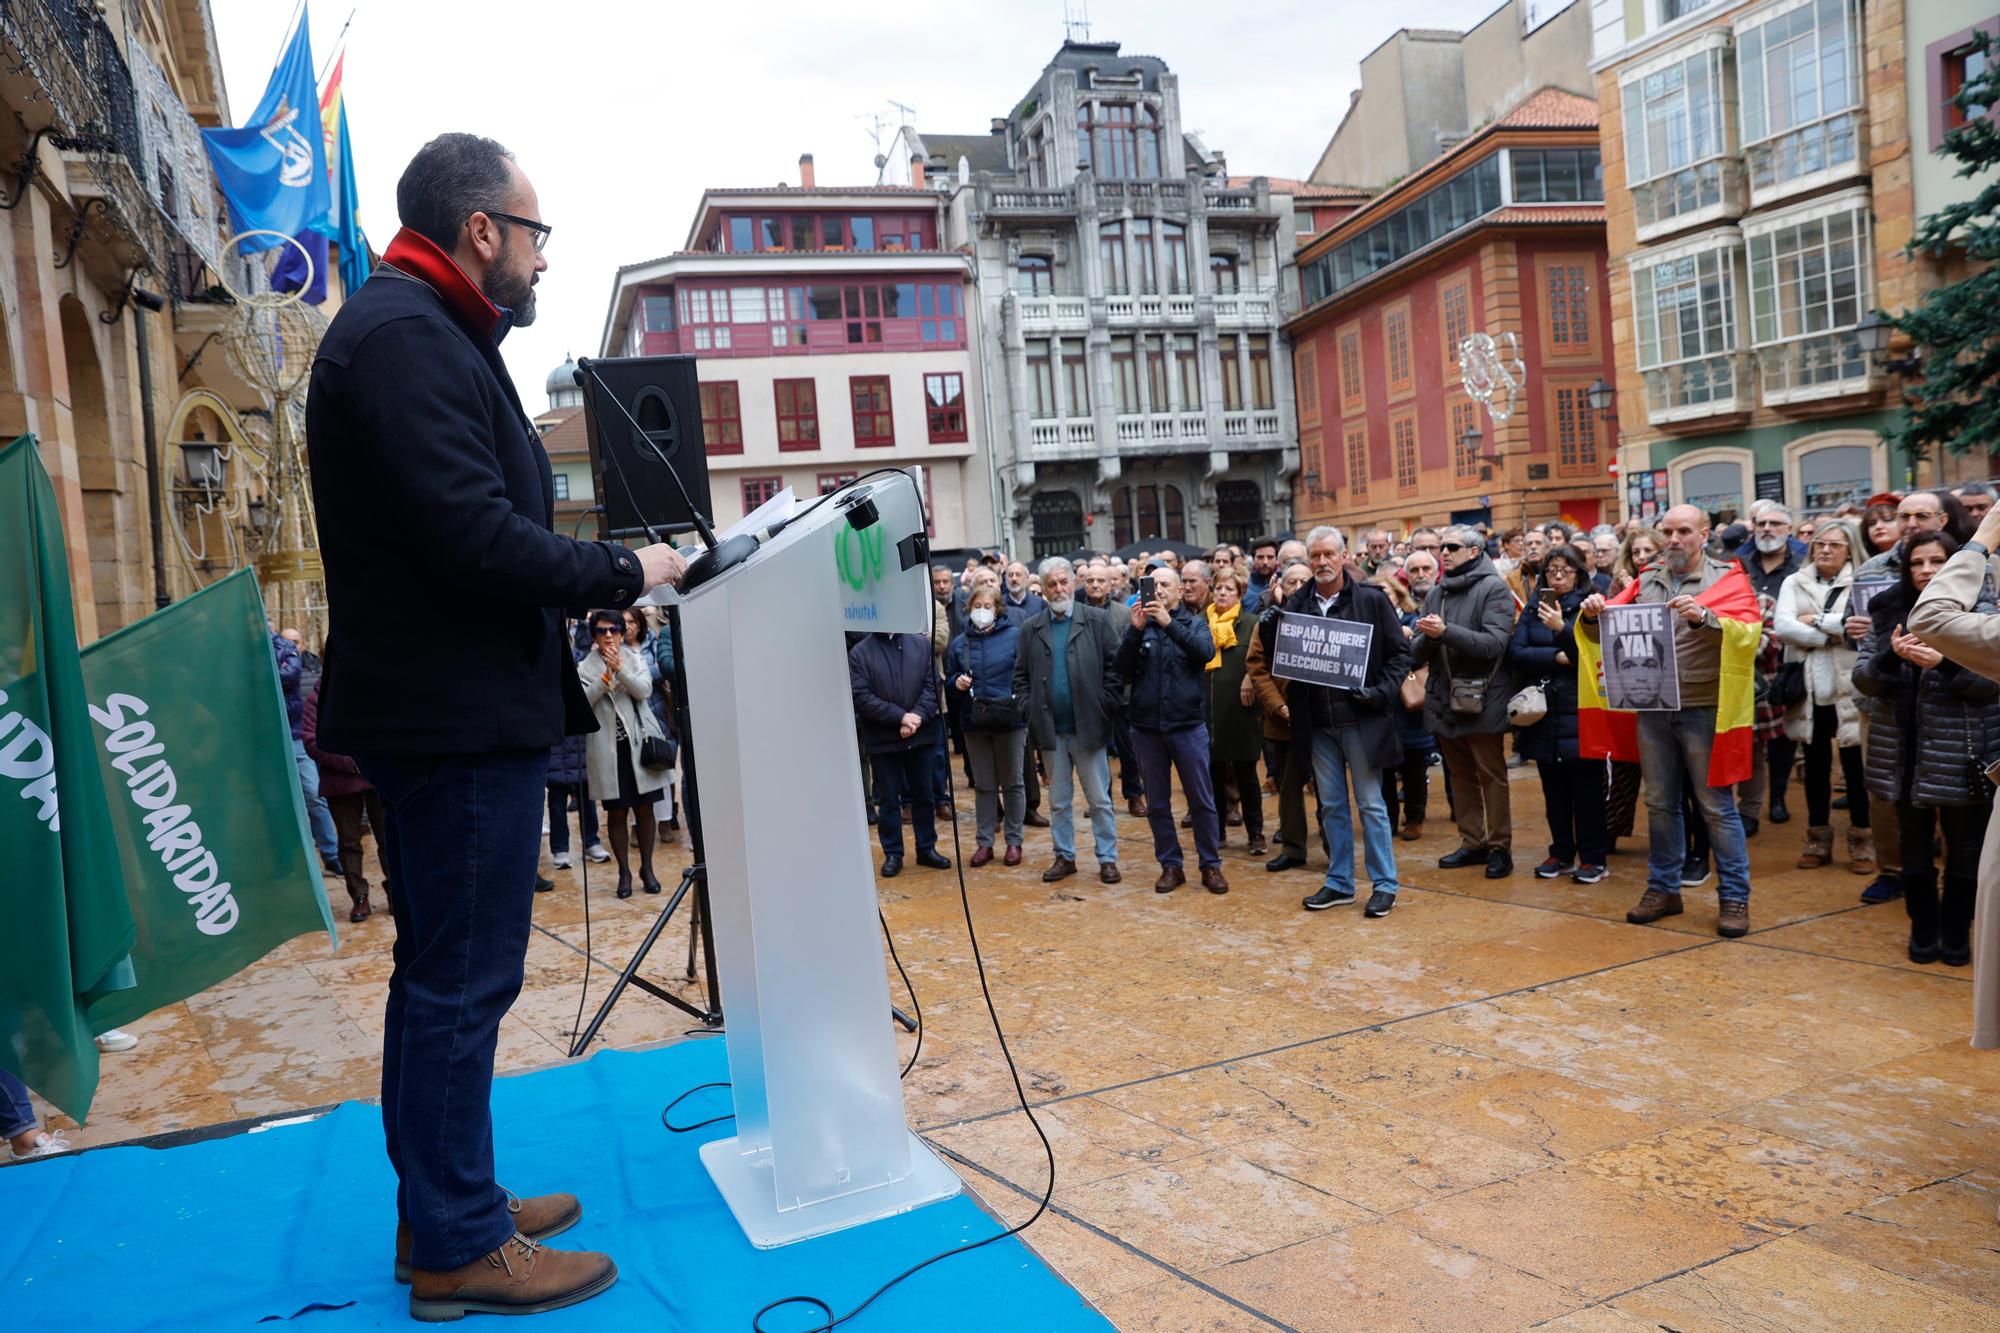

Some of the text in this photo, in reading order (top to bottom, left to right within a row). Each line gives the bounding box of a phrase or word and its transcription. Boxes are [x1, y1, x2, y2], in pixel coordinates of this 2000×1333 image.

[1608, 608, 1664, 635] ¡VETE
[1302, 639, 1342, 658] VOTAR!
[1328, 630, 1367, 648] QUIERE
[1620, 634, 1654, 658] YA!
[1276, 652, 1364, 678] ¡ELECCIONES YA!
[88, 692, 240, 936] SOLIDARIDAD
